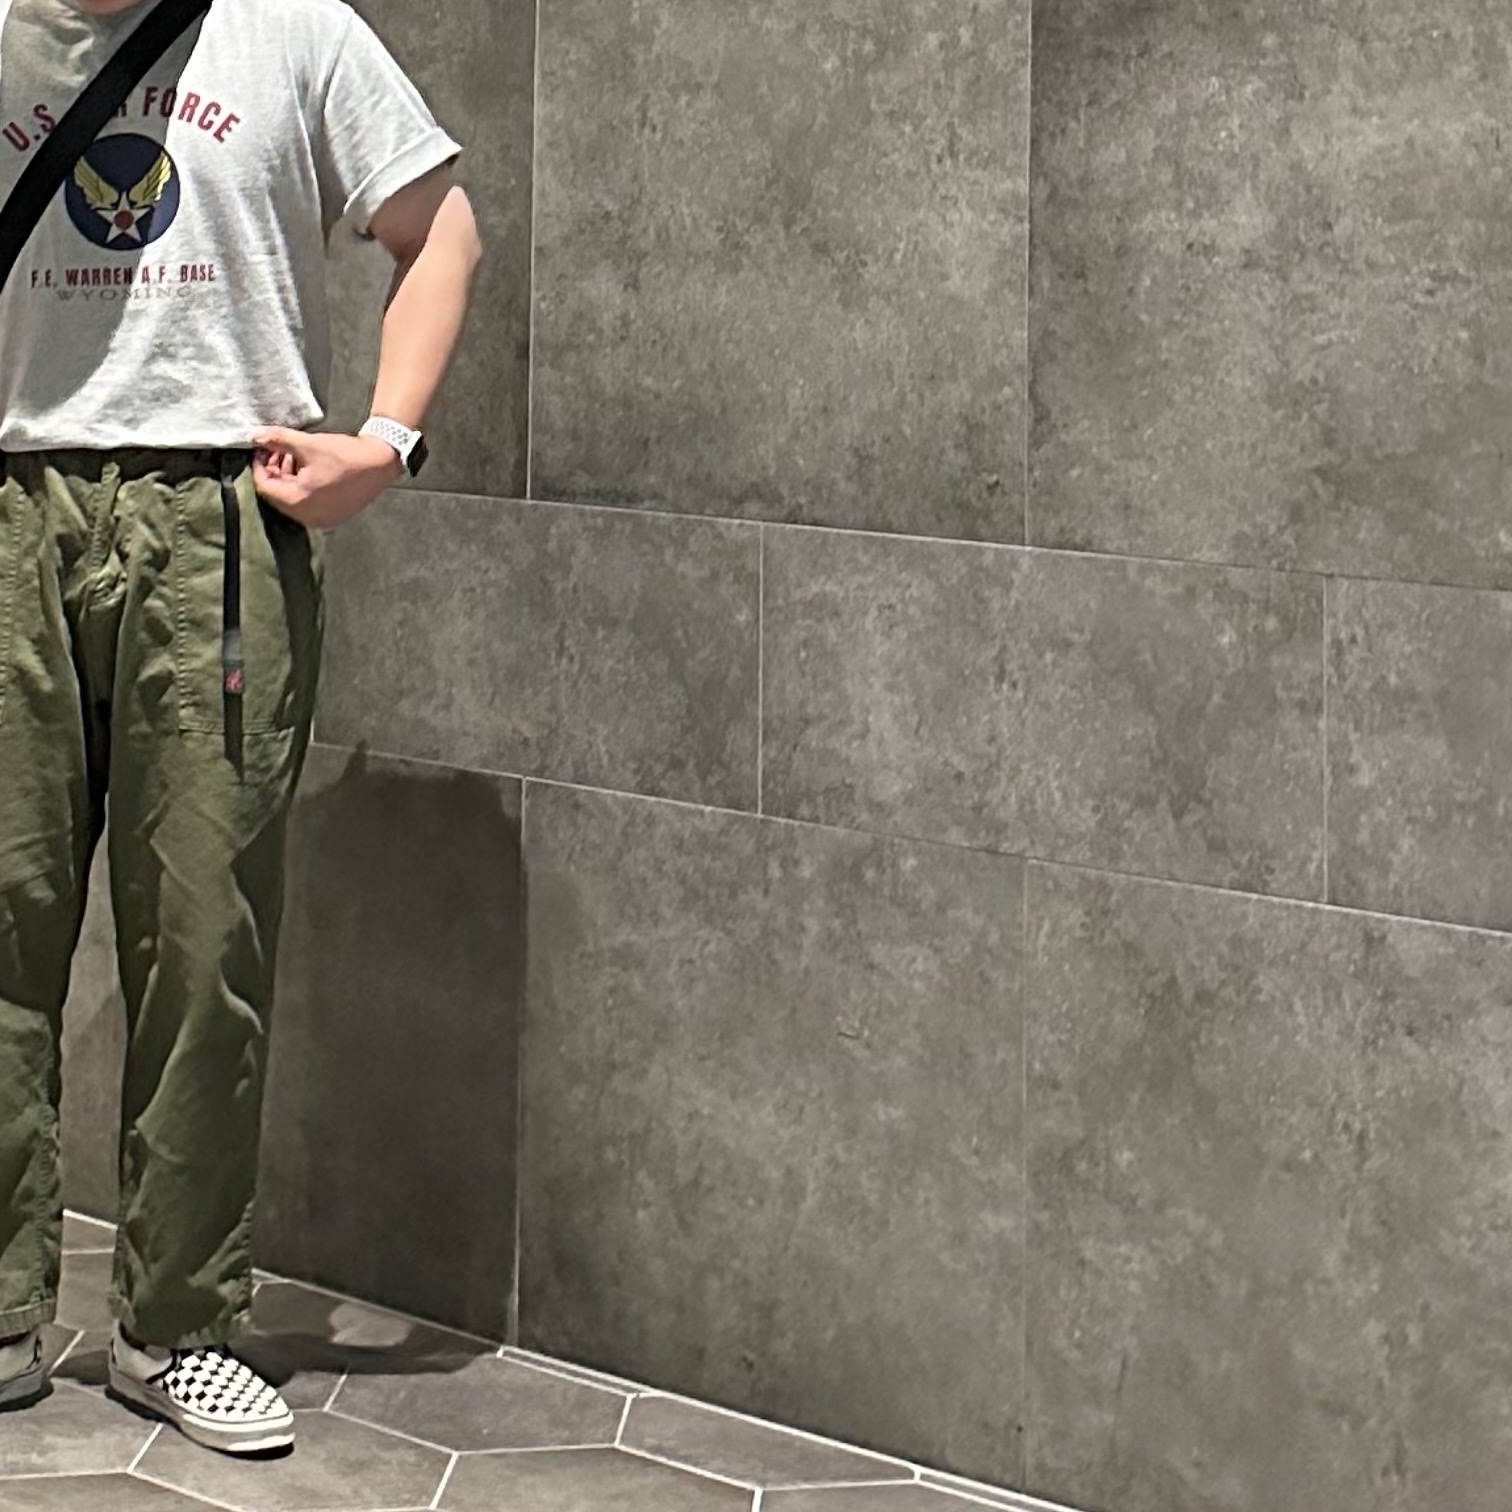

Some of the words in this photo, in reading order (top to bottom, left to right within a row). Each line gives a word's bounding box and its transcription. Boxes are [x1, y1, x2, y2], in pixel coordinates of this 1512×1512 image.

[142, 86, 241, 144] FORCE
[66, 266, 133, 286] WARREN
[180, 263, 217, 282] BASE
